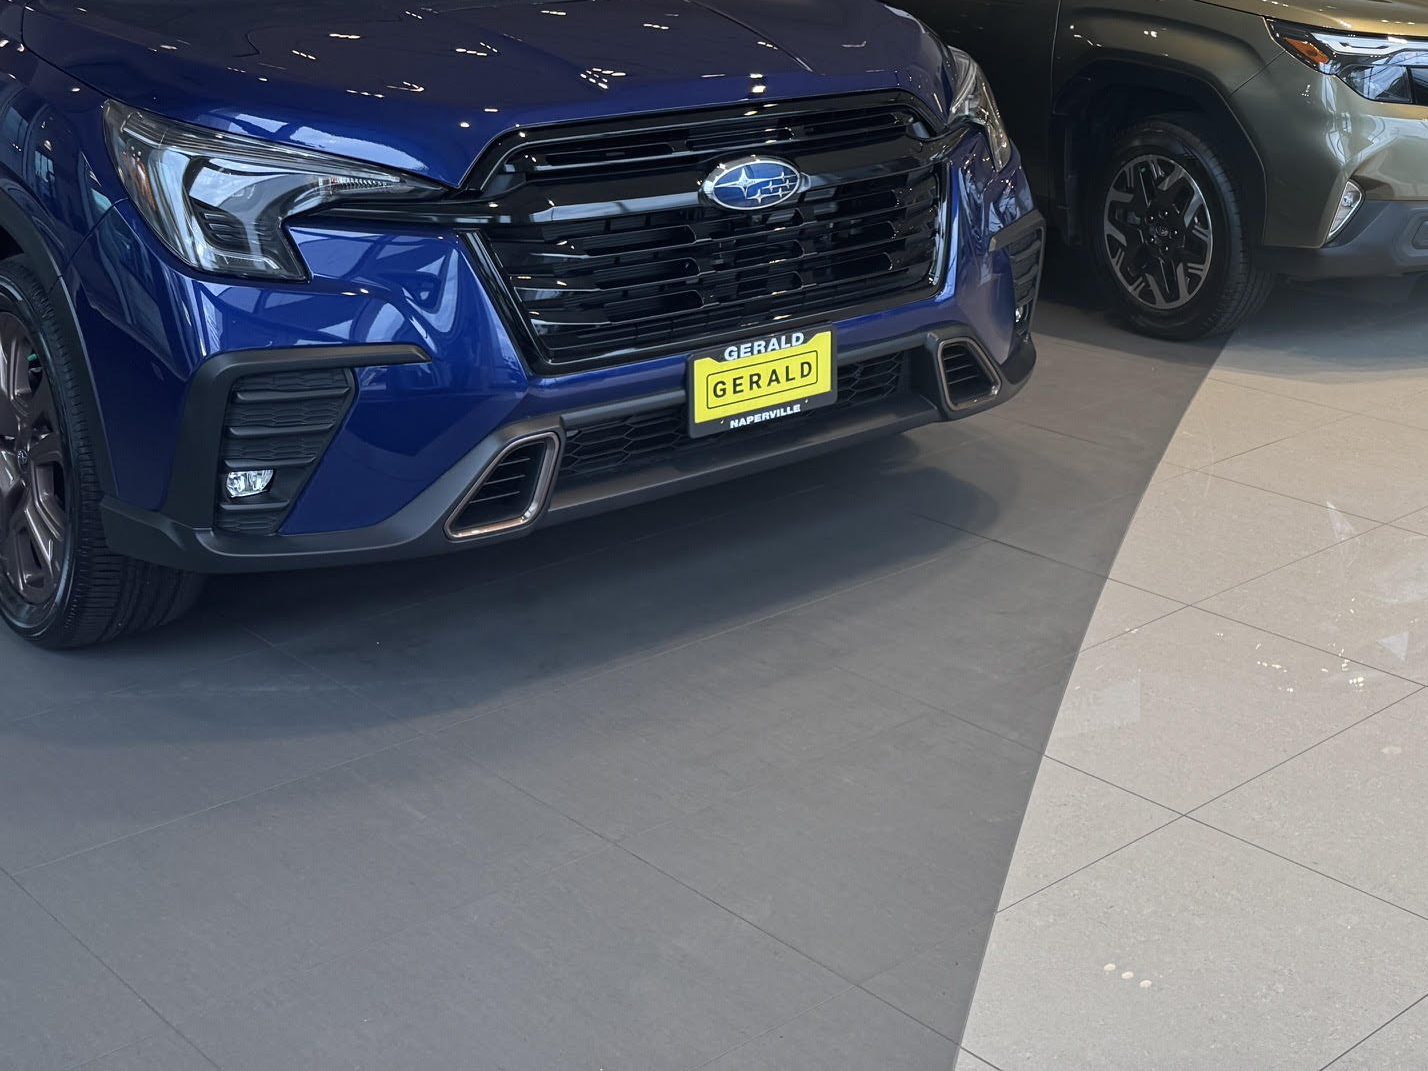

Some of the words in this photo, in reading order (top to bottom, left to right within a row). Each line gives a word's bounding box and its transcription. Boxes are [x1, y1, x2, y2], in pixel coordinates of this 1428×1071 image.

[724, 332, 804, 361] GERALD
[713, 361, 812, 398] GERALD
[730, 404, 801, 429] NAPERVILLE
